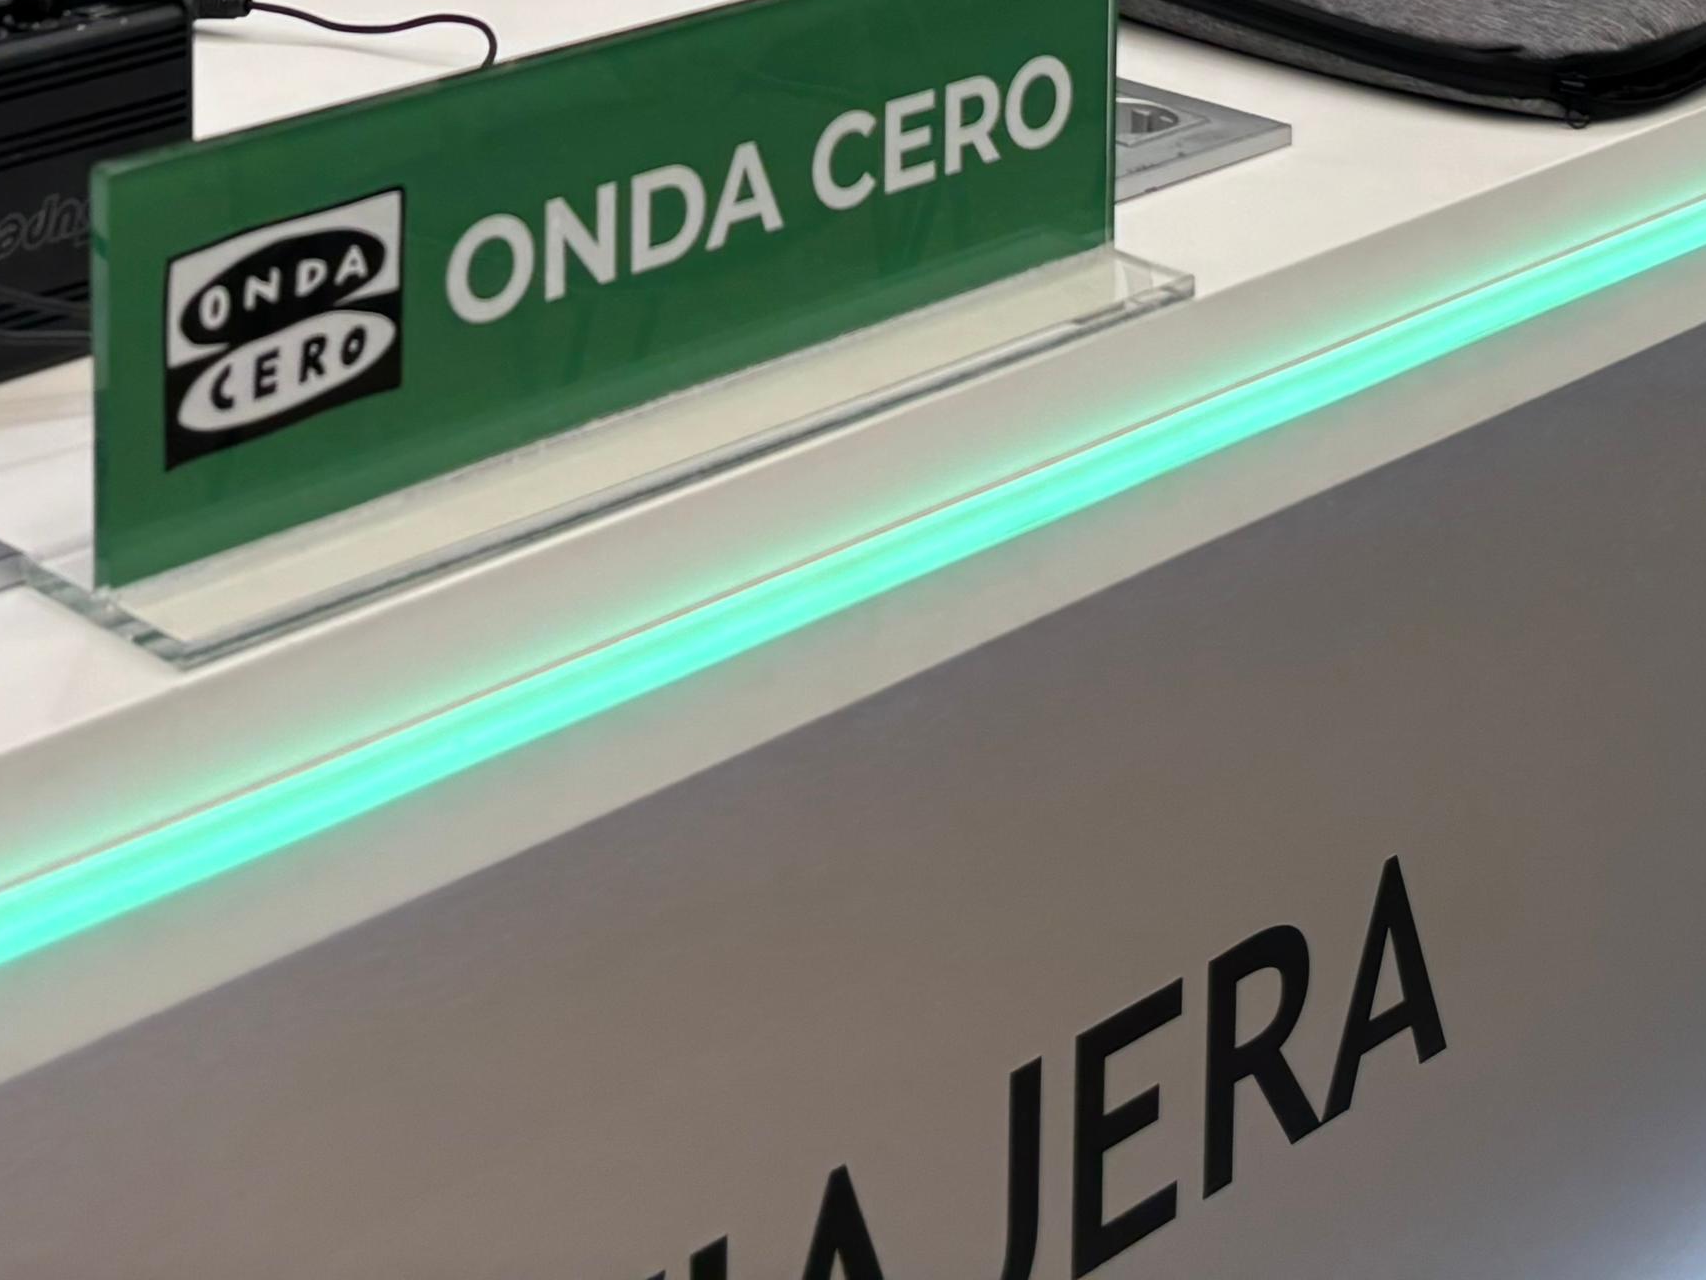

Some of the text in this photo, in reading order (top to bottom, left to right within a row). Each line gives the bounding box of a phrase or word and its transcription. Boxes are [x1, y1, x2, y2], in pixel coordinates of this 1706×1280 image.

[445, 54, 1073, 324] ONDA CERO
[198, 243, 369, 331] ONDA
[210, 324, 368, 411] CERO
